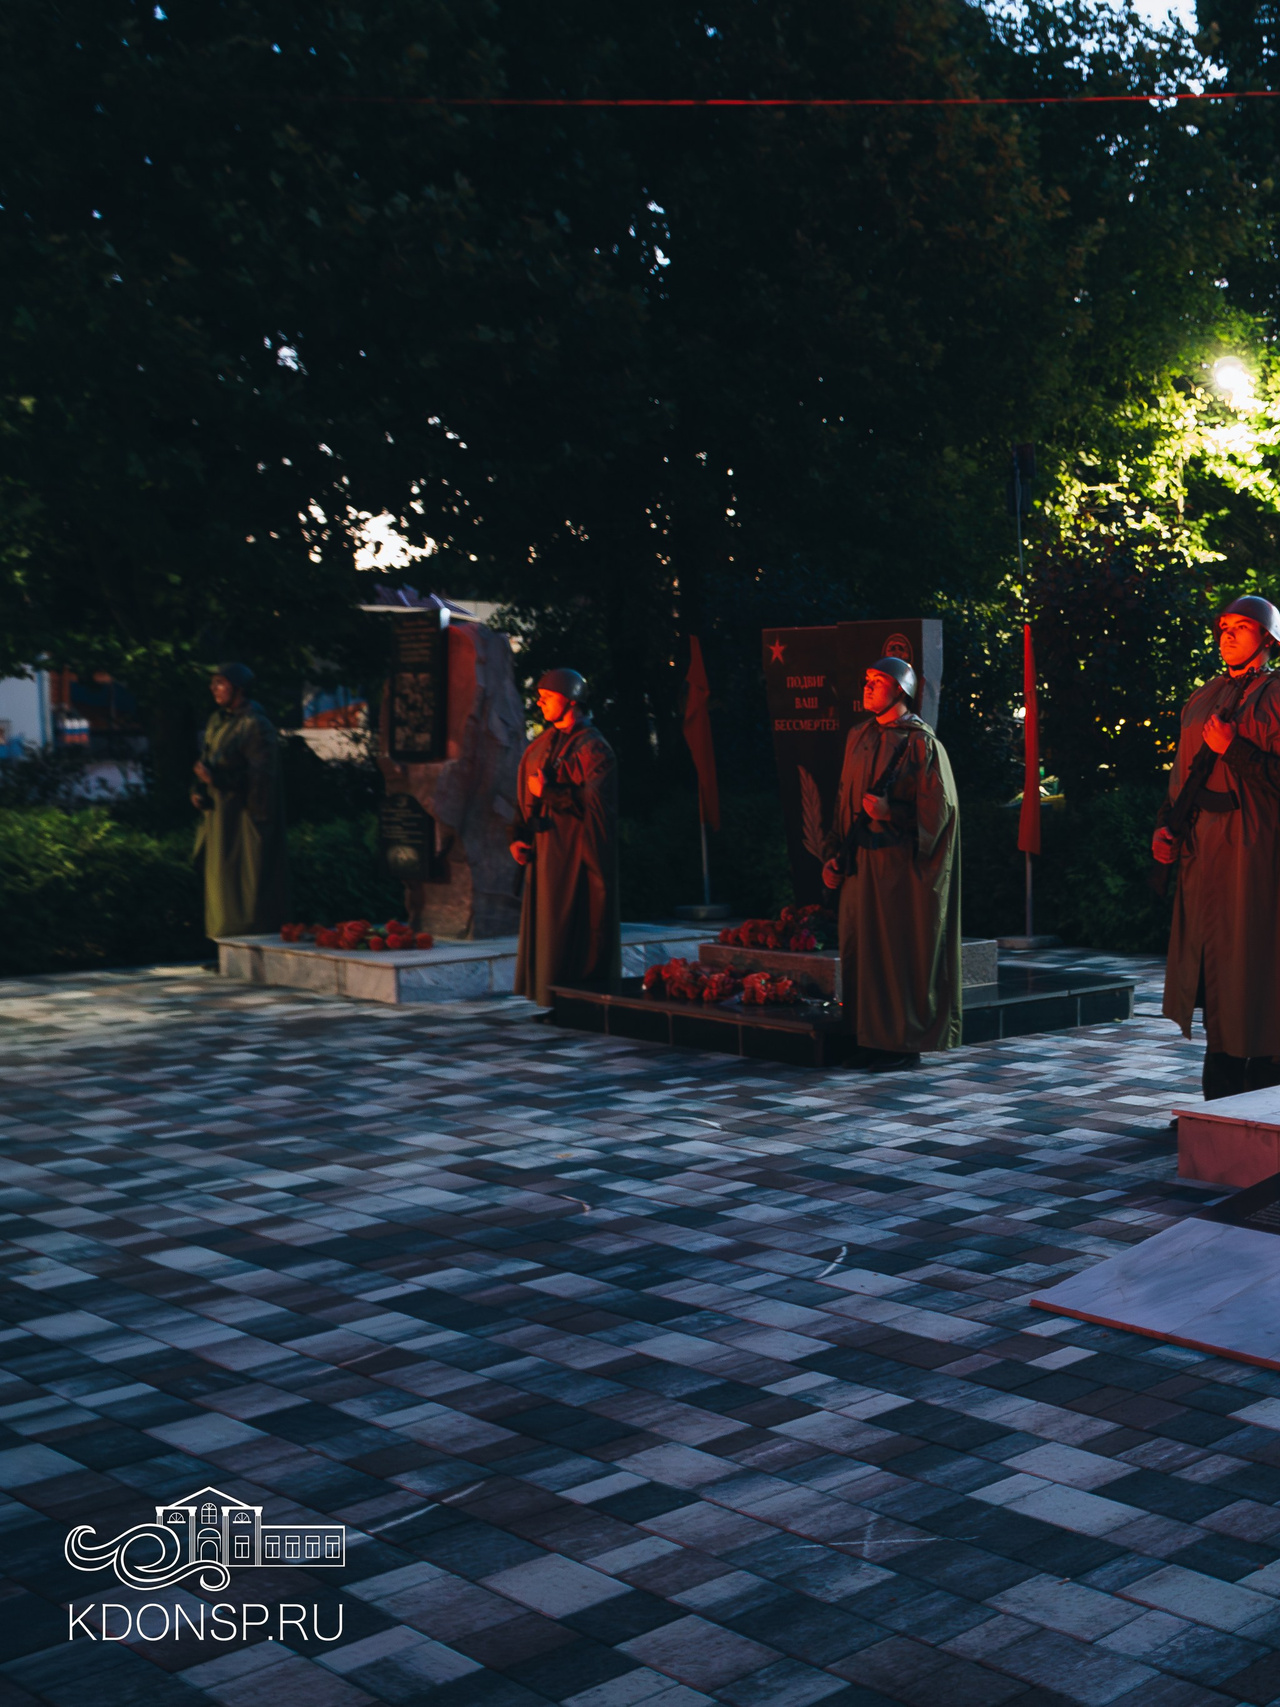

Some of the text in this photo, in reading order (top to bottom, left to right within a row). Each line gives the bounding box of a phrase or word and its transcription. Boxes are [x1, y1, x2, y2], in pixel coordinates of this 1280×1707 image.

[786, 675, 826, 690] ПОДВИГ
[794, 696, 819, 710] ВАШ
[774, 718, 840, 731] БЕССМЕРТЕН
